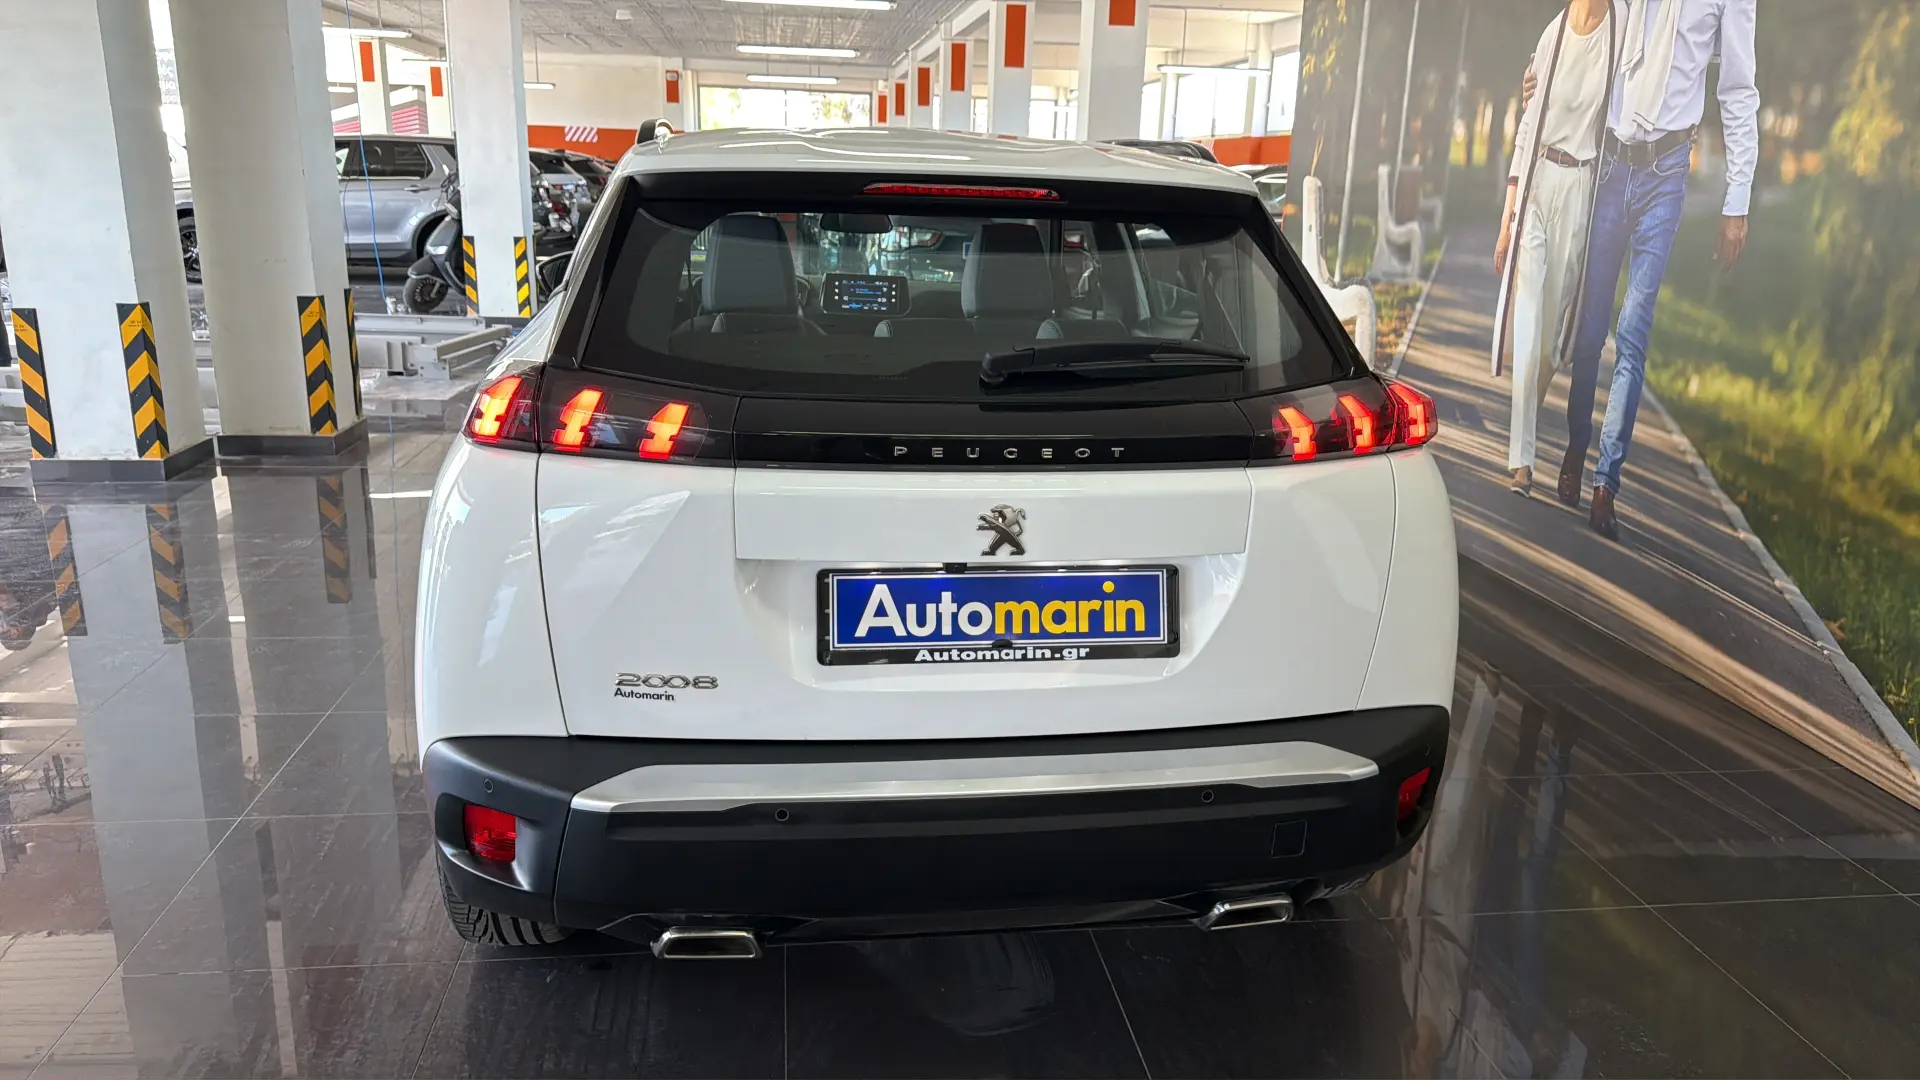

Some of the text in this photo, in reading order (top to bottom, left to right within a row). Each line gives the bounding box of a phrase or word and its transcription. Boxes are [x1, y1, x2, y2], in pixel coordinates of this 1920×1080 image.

[893, 445, 1125, 459] PEUGEOT
[855, 581, 1145, 637] Automarin
[914, 646, 1090, 662] Automarin.gr
[615, 673, 719, 689] 2008
[614, 688, 675, 701] Automarin
